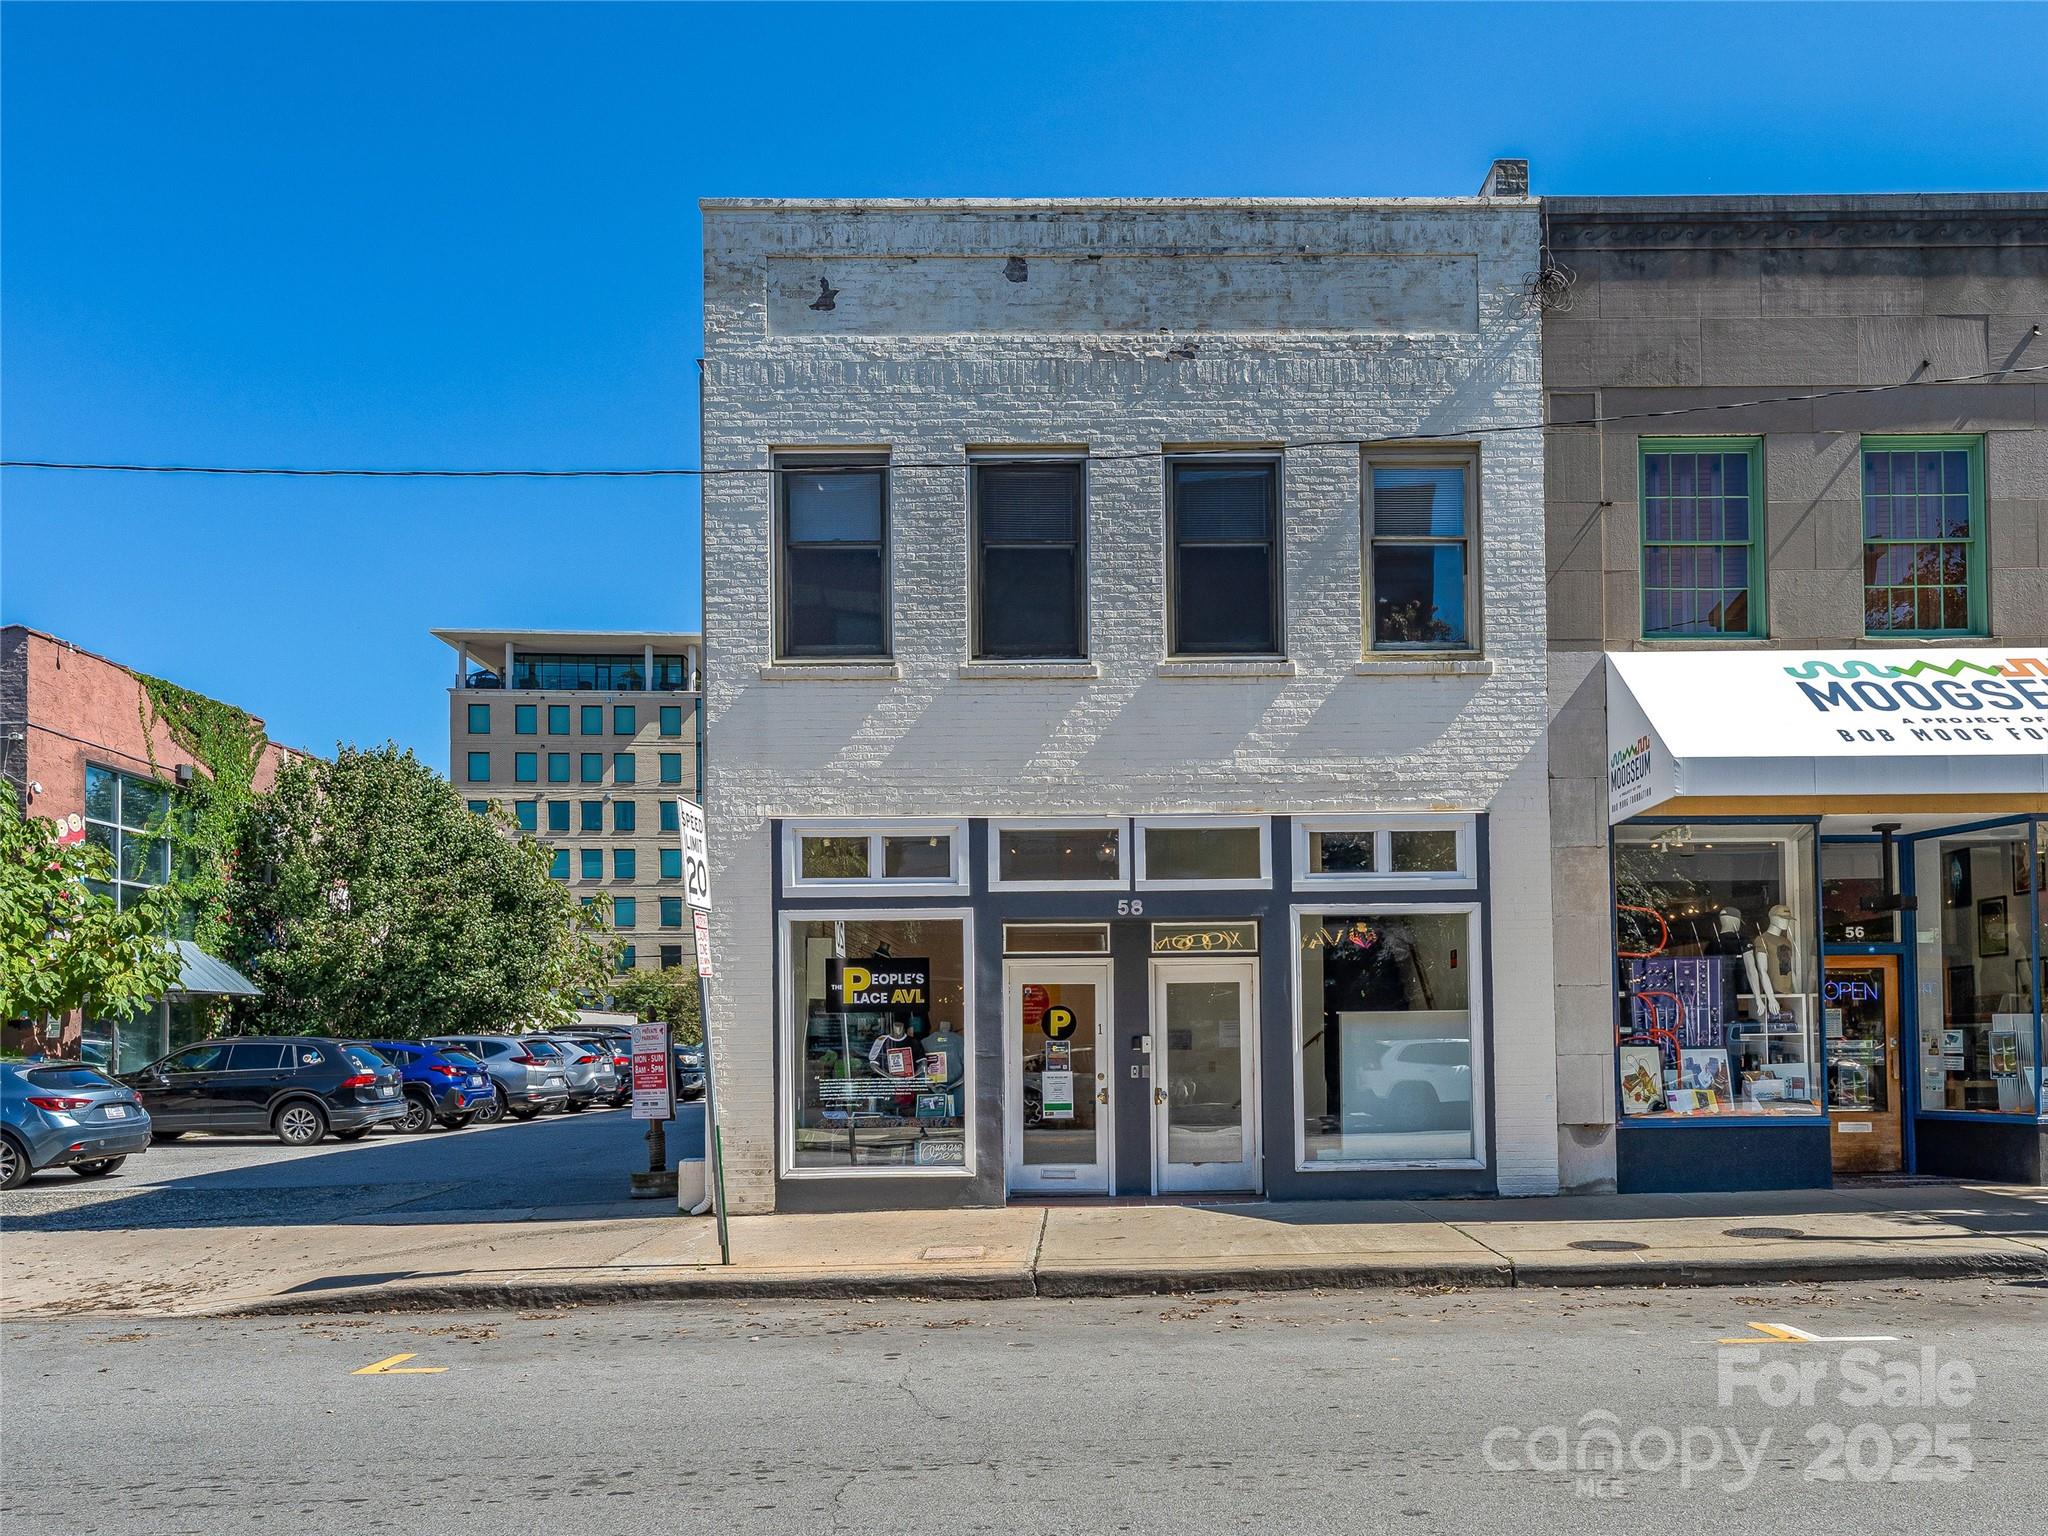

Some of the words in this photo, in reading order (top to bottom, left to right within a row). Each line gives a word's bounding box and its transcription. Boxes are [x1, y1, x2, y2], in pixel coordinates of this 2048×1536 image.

[1922, 716, 2010, 724] PROJECT
[1836, 728, 1895, 742] BOB
[1910, 728, 1994, 742] MOOG
[1611, 750, 1651, 793] MOOGSEUM
[681, 810, 704, 833] SPEED
[685, 833, 702, 855] LIMIT
[686, 855, 707, 897] 20
[1117, 900, 1144, 915] 58
[1845, 926, 1865, 938] 56
[890, 988, 925, 1004] AVL
[1824, 981, 1878, 1001] OPEN
[1050, 1009, 1072, 1037] P
[1098, 1023, 1103, 1035] 1
[634, 1055, 647, 1063] MON
[651, 1054, 664, 1063] SUN
[634, 1065, 646, 1074] 8AM
[651, 1064, 664, 1073] 5PM
[922, 1144, 962, 1165] Open
